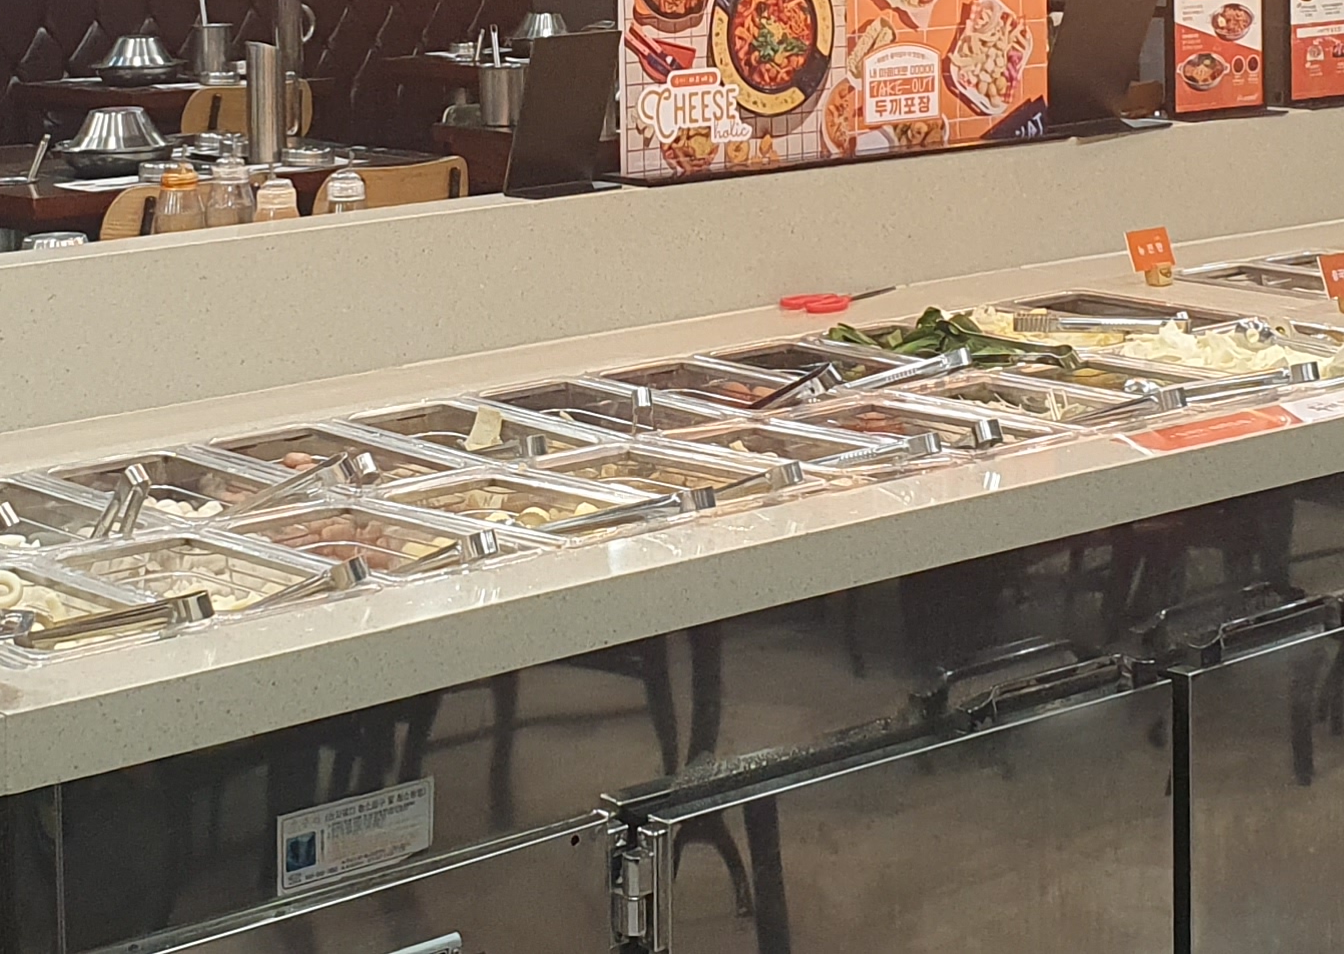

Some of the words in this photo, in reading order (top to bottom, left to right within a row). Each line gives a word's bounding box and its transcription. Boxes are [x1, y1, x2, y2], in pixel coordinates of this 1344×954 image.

[870, 77, 934, 97] TAKE-OUT
[641, 88, 737, 139] CHEESE
[875, 95, 931, 117] 두끼포장
[714, 120, 750, 139] holic
